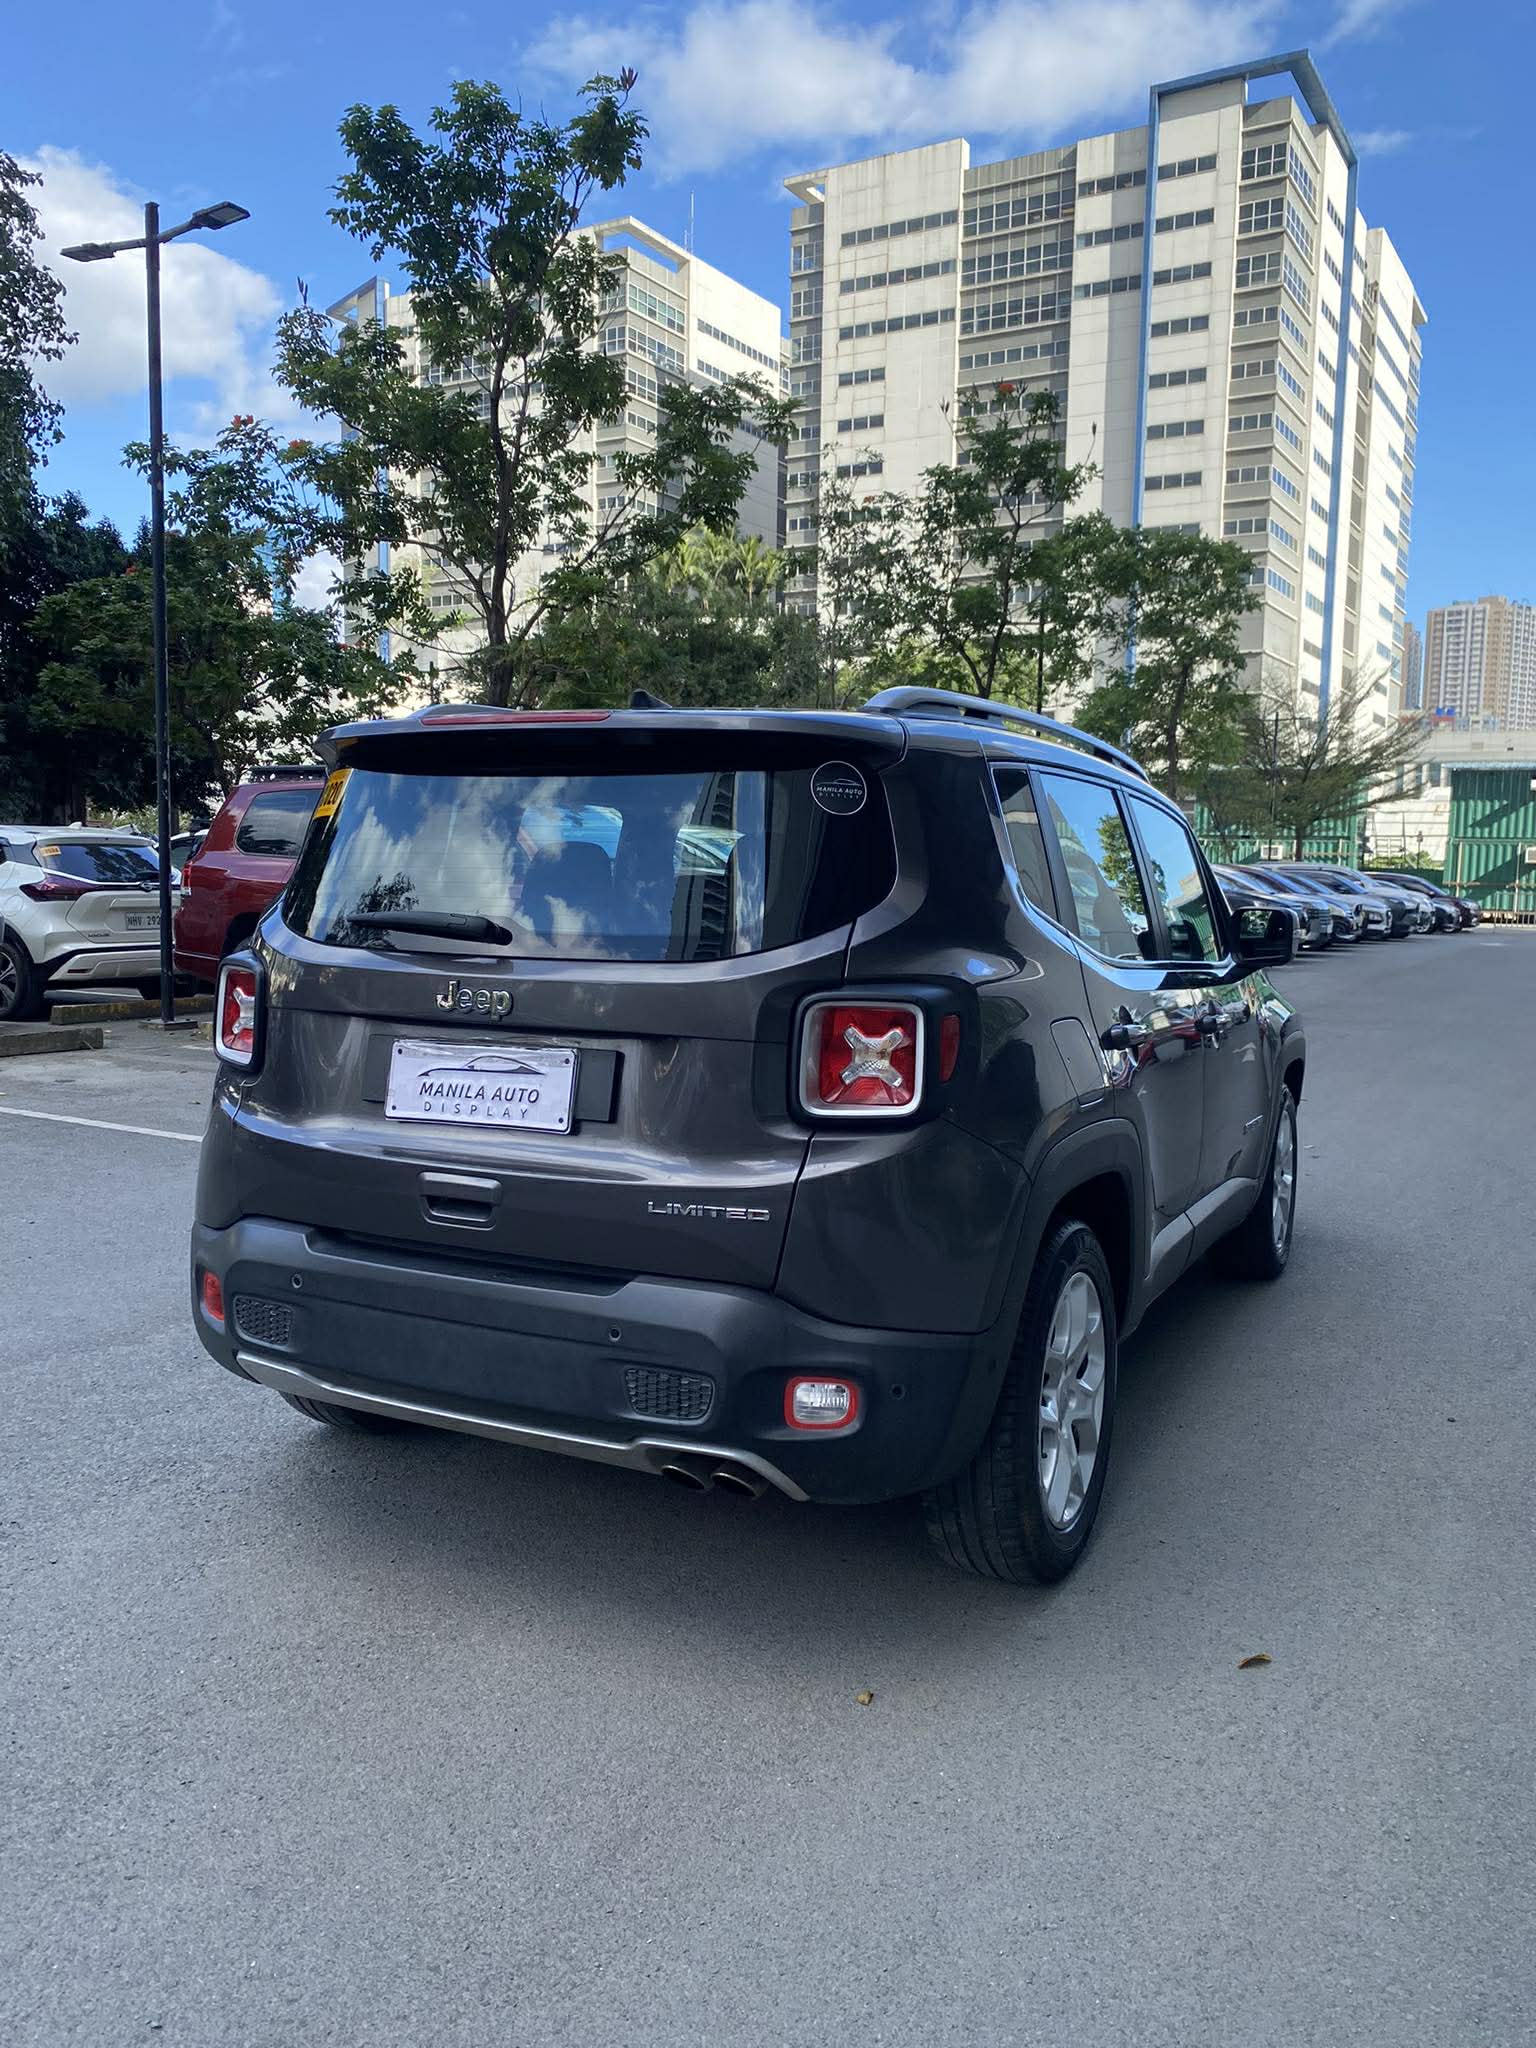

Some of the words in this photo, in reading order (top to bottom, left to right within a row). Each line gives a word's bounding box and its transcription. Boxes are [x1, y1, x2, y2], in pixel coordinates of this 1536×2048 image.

[435, 980, 513, 1021] Jeep
[419, 1081, 485, 1100] MANILA
[491, 1086, 540, 1104] AUTO
[423, 1101, 528, 1119] DISPLAY
[647, 1201, 770, 1221] LIMITED
